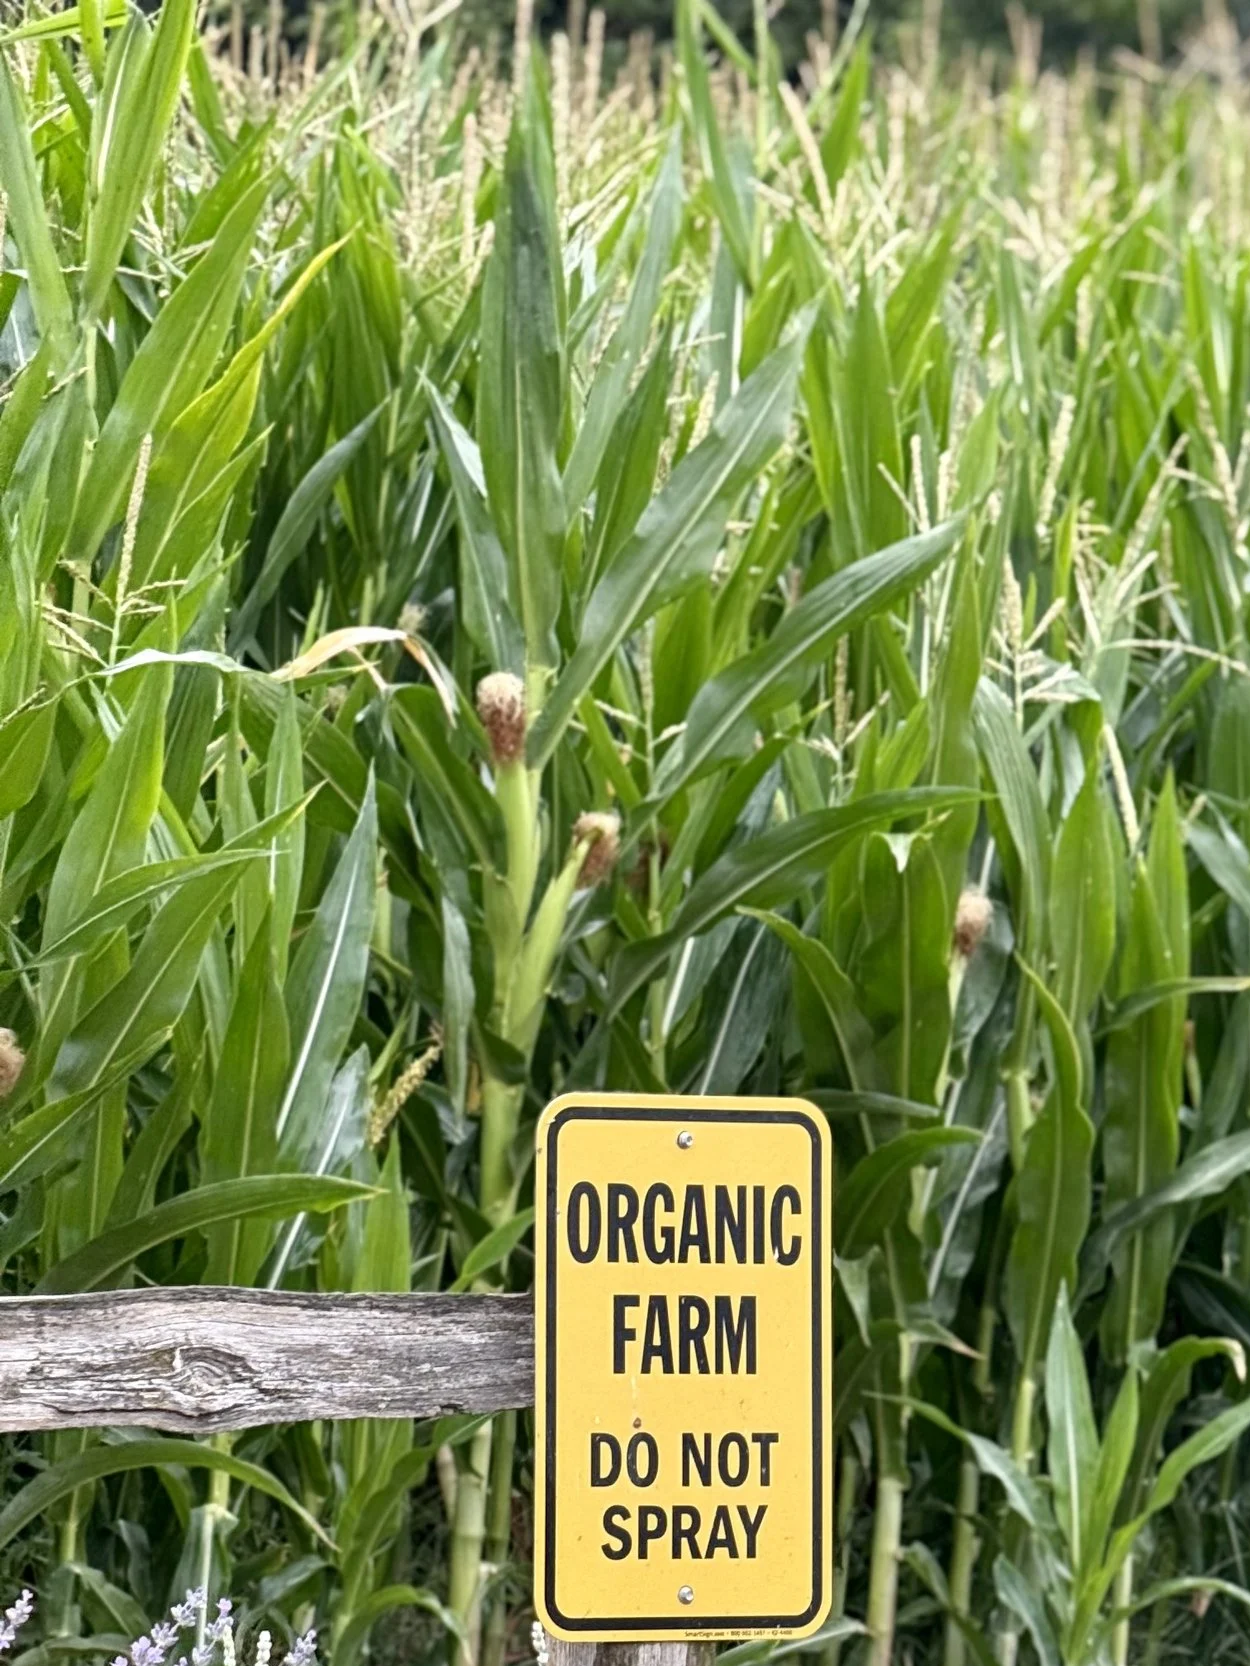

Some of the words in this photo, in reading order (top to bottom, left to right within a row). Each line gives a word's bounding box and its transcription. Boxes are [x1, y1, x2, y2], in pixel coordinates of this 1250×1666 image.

[566, 1181, 803, 1266] ORGANIC
[612, 1294, 758, 1375] FARM
[590, 1432, 660, 1488] DO
[681, 1432, 780, 1488] NOT
[601, 1505, 769, 1561] SPRAY
